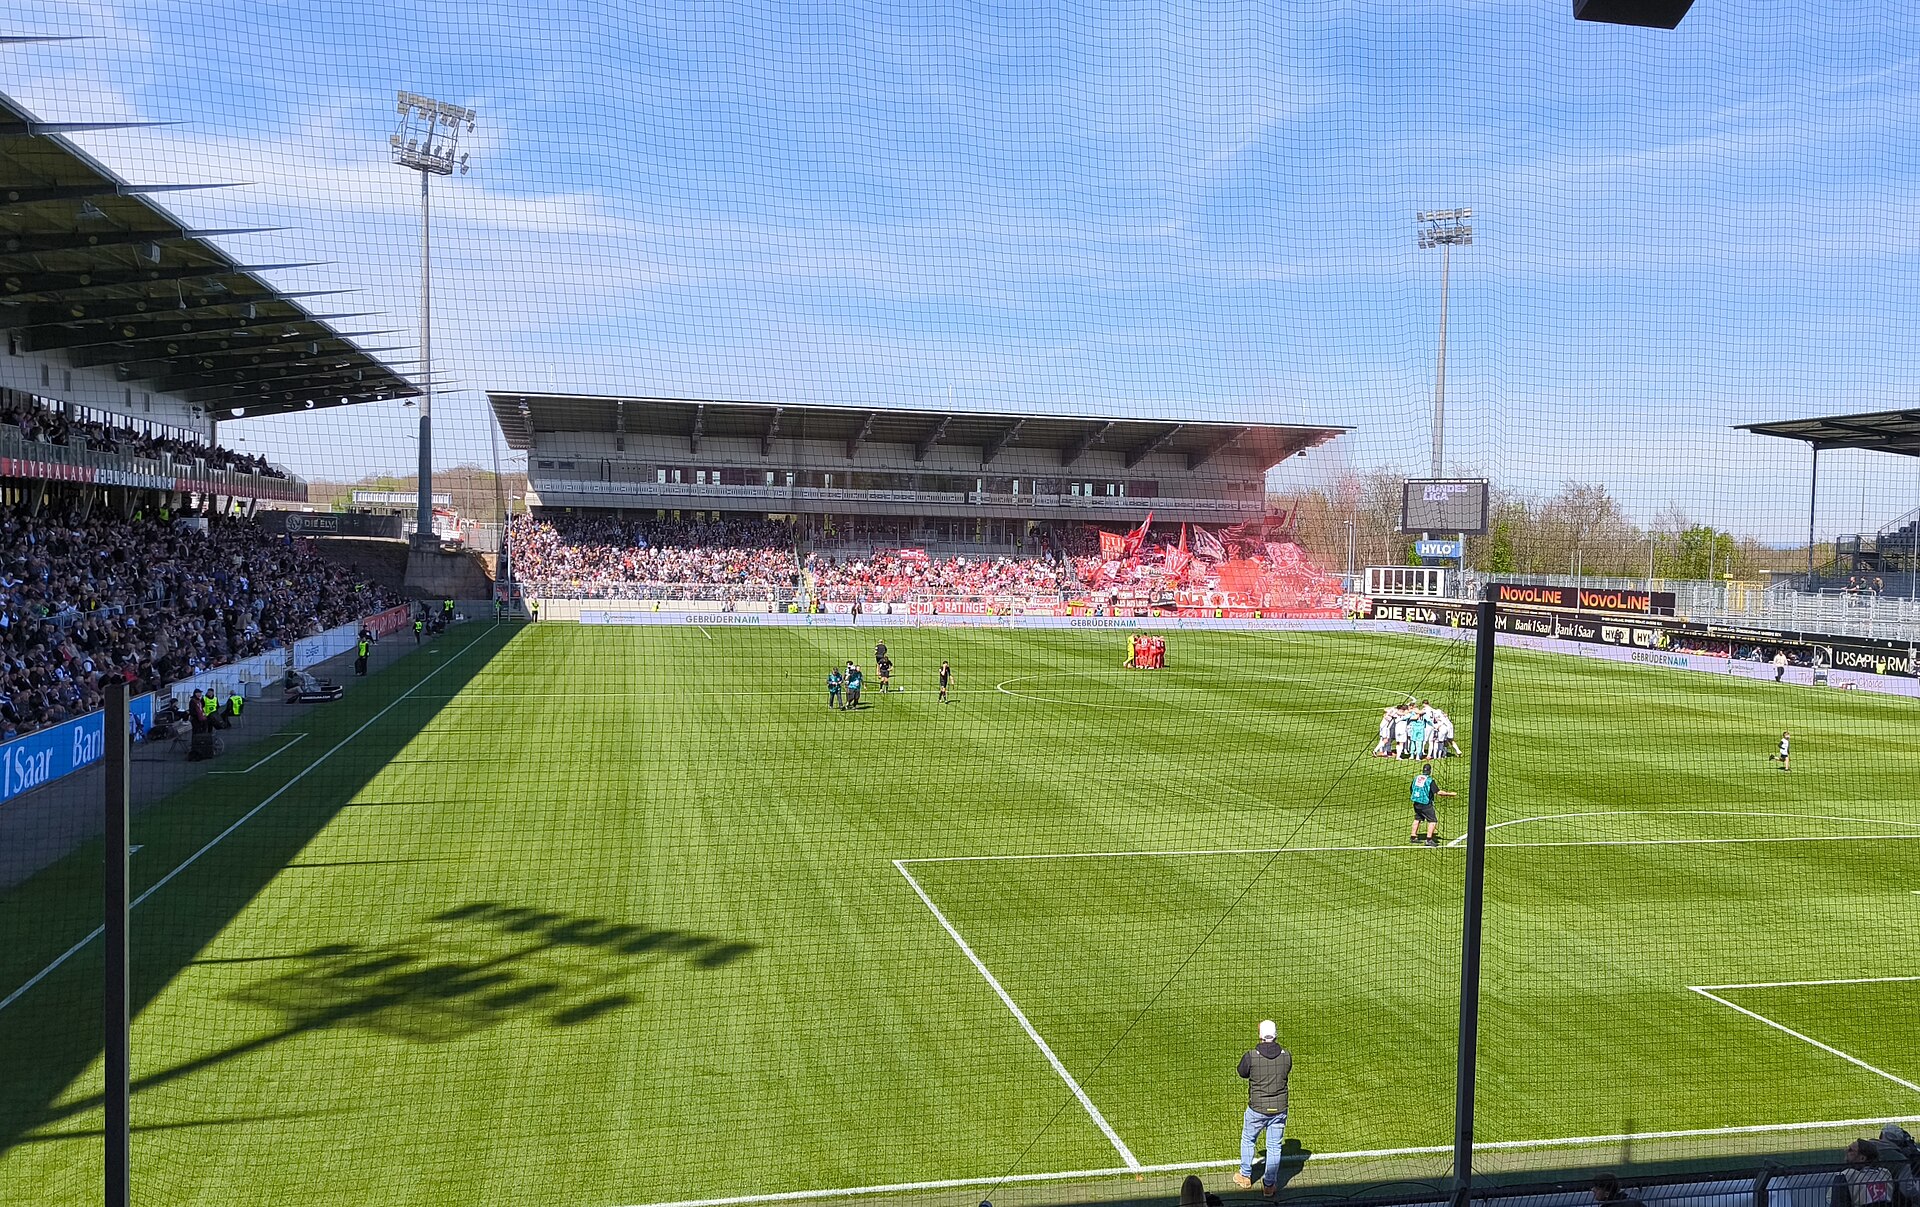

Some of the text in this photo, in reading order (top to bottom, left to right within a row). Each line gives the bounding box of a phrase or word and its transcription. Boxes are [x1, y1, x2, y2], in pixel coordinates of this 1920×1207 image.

[1424, 484, 1468, 493] BUNDES
[1422, 493, 1449, 501] LIGA
[1421, 543, 1452, 555] HYLO
[944, 602, 987, 613] RATINGE
[1375, 606, 1402, 621] DIE
[1555, 622, 1596, 639] Bank1Saar
[1605, 629, 1625, 640] HYO
